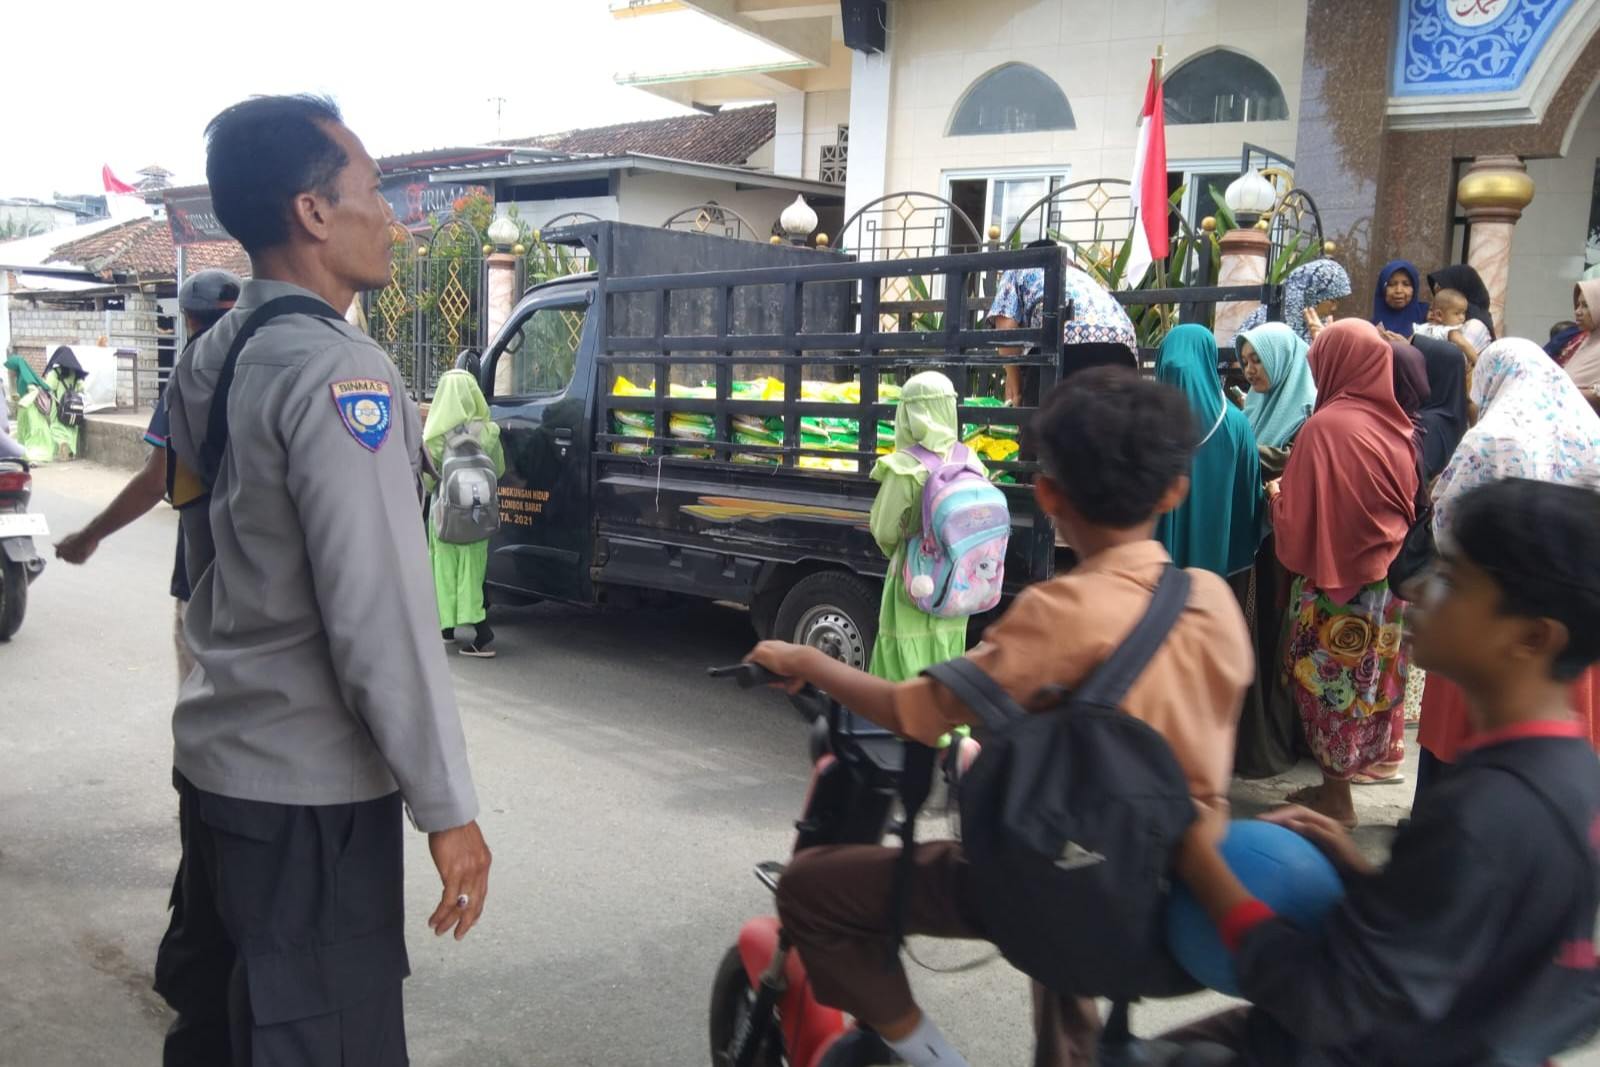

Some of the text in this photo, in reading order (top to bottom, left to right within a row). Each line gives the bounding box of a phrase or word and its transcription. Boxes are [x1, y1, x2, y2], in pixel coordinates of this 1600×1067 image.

[338, 382, 383, 393] BINMAS
[497, 487, 550, 501] LINGKUNGAN HIDUP
[525, 501, 542, 512] BARAT
[514, 514, 533, 525] 2021
